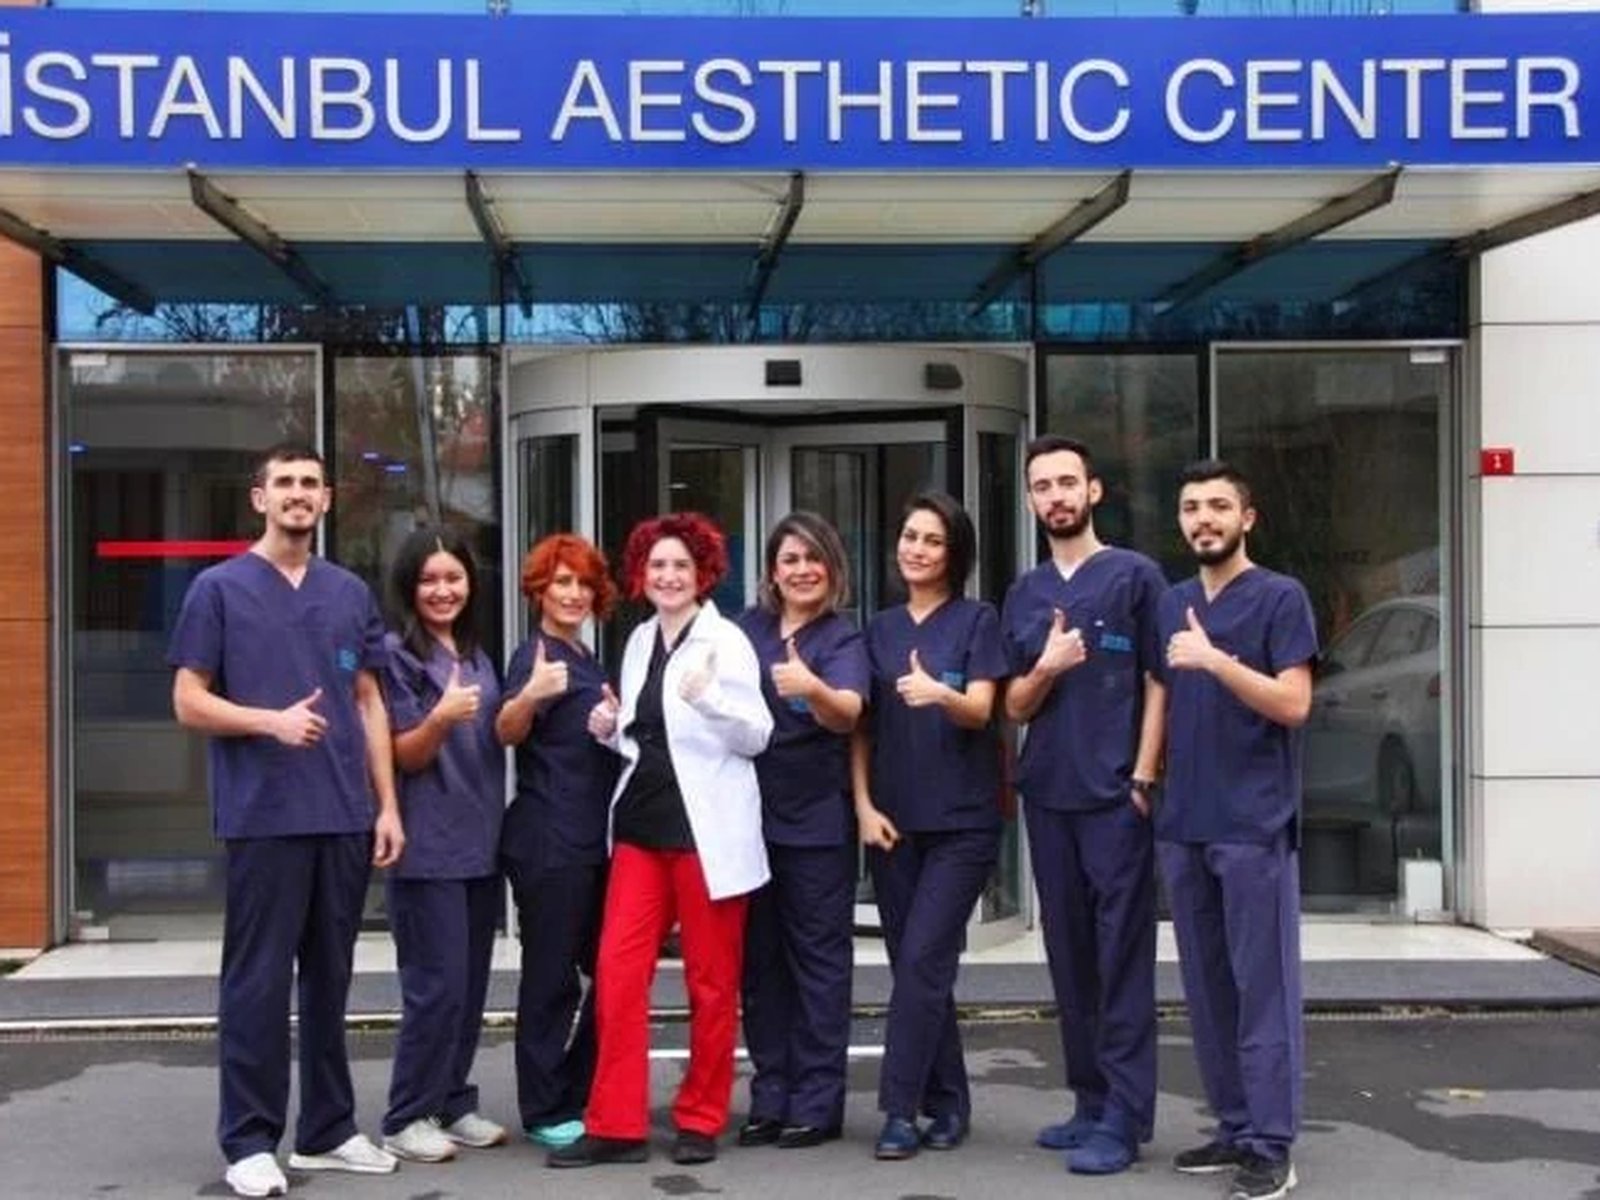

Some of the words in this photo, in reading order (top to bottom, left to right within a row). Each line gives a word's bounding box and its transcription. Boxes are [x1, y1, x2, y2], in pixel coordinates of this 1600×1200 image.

[0, 31, 521, 142] İSTANBUL
[551, 58, 1130, 143] AESTHETIC
[1165, 57, 1581, 142] CENTER
